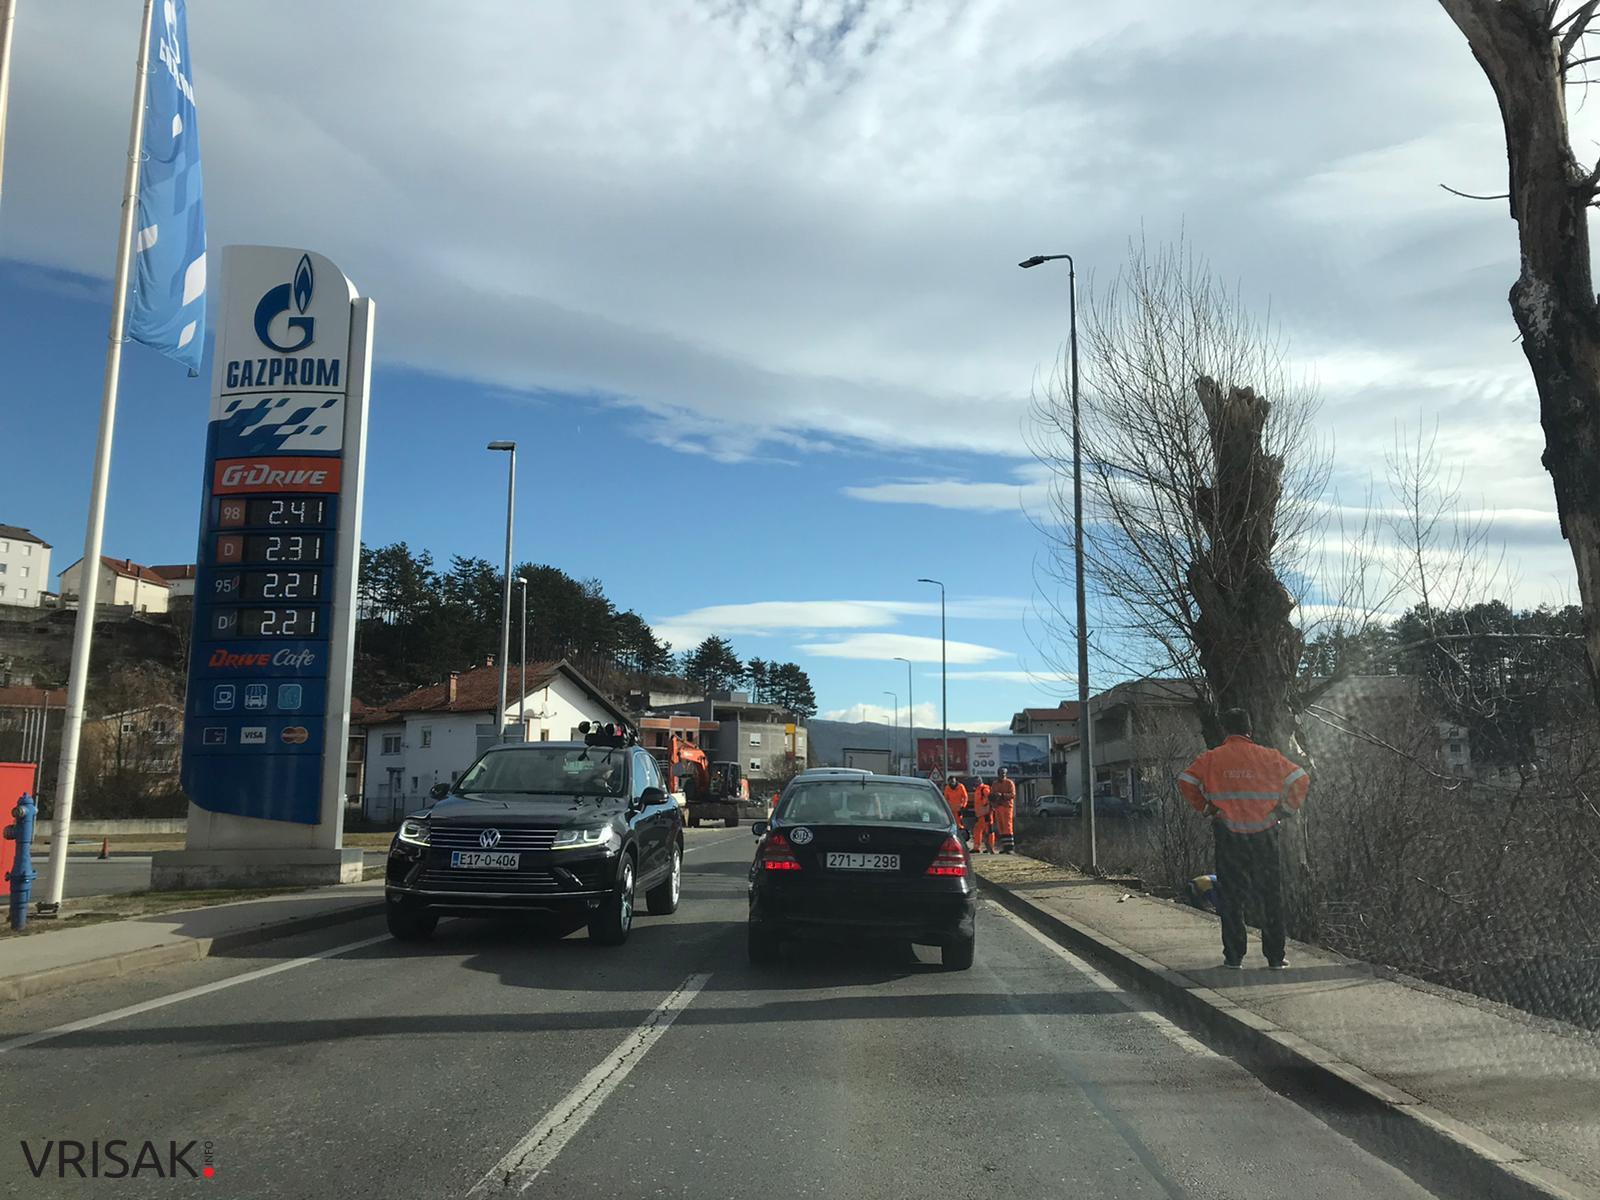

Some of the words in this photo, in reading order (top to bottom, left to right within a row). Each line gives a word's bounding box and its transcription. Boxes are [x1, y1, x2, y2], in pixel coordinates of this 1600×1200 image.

[226, 357, 340, 388] GAZPROM
[224, 506, 240, 520] 98
[268, 500, 324, 525] 2.41
[224, 544, 234, 557] D
[266, 536, 321, 561] 2.31
[215, 579, 232, 593] 95
[263, 572, 318, 598] 2.21
[218, 615, 228, 630] D
[260, 610, 316, 635] 2.21
[272, 649, 315, 669] Cafe
[244, 731, 263, 739] VISA
[829, 854, 898, 868] 271-J-298
